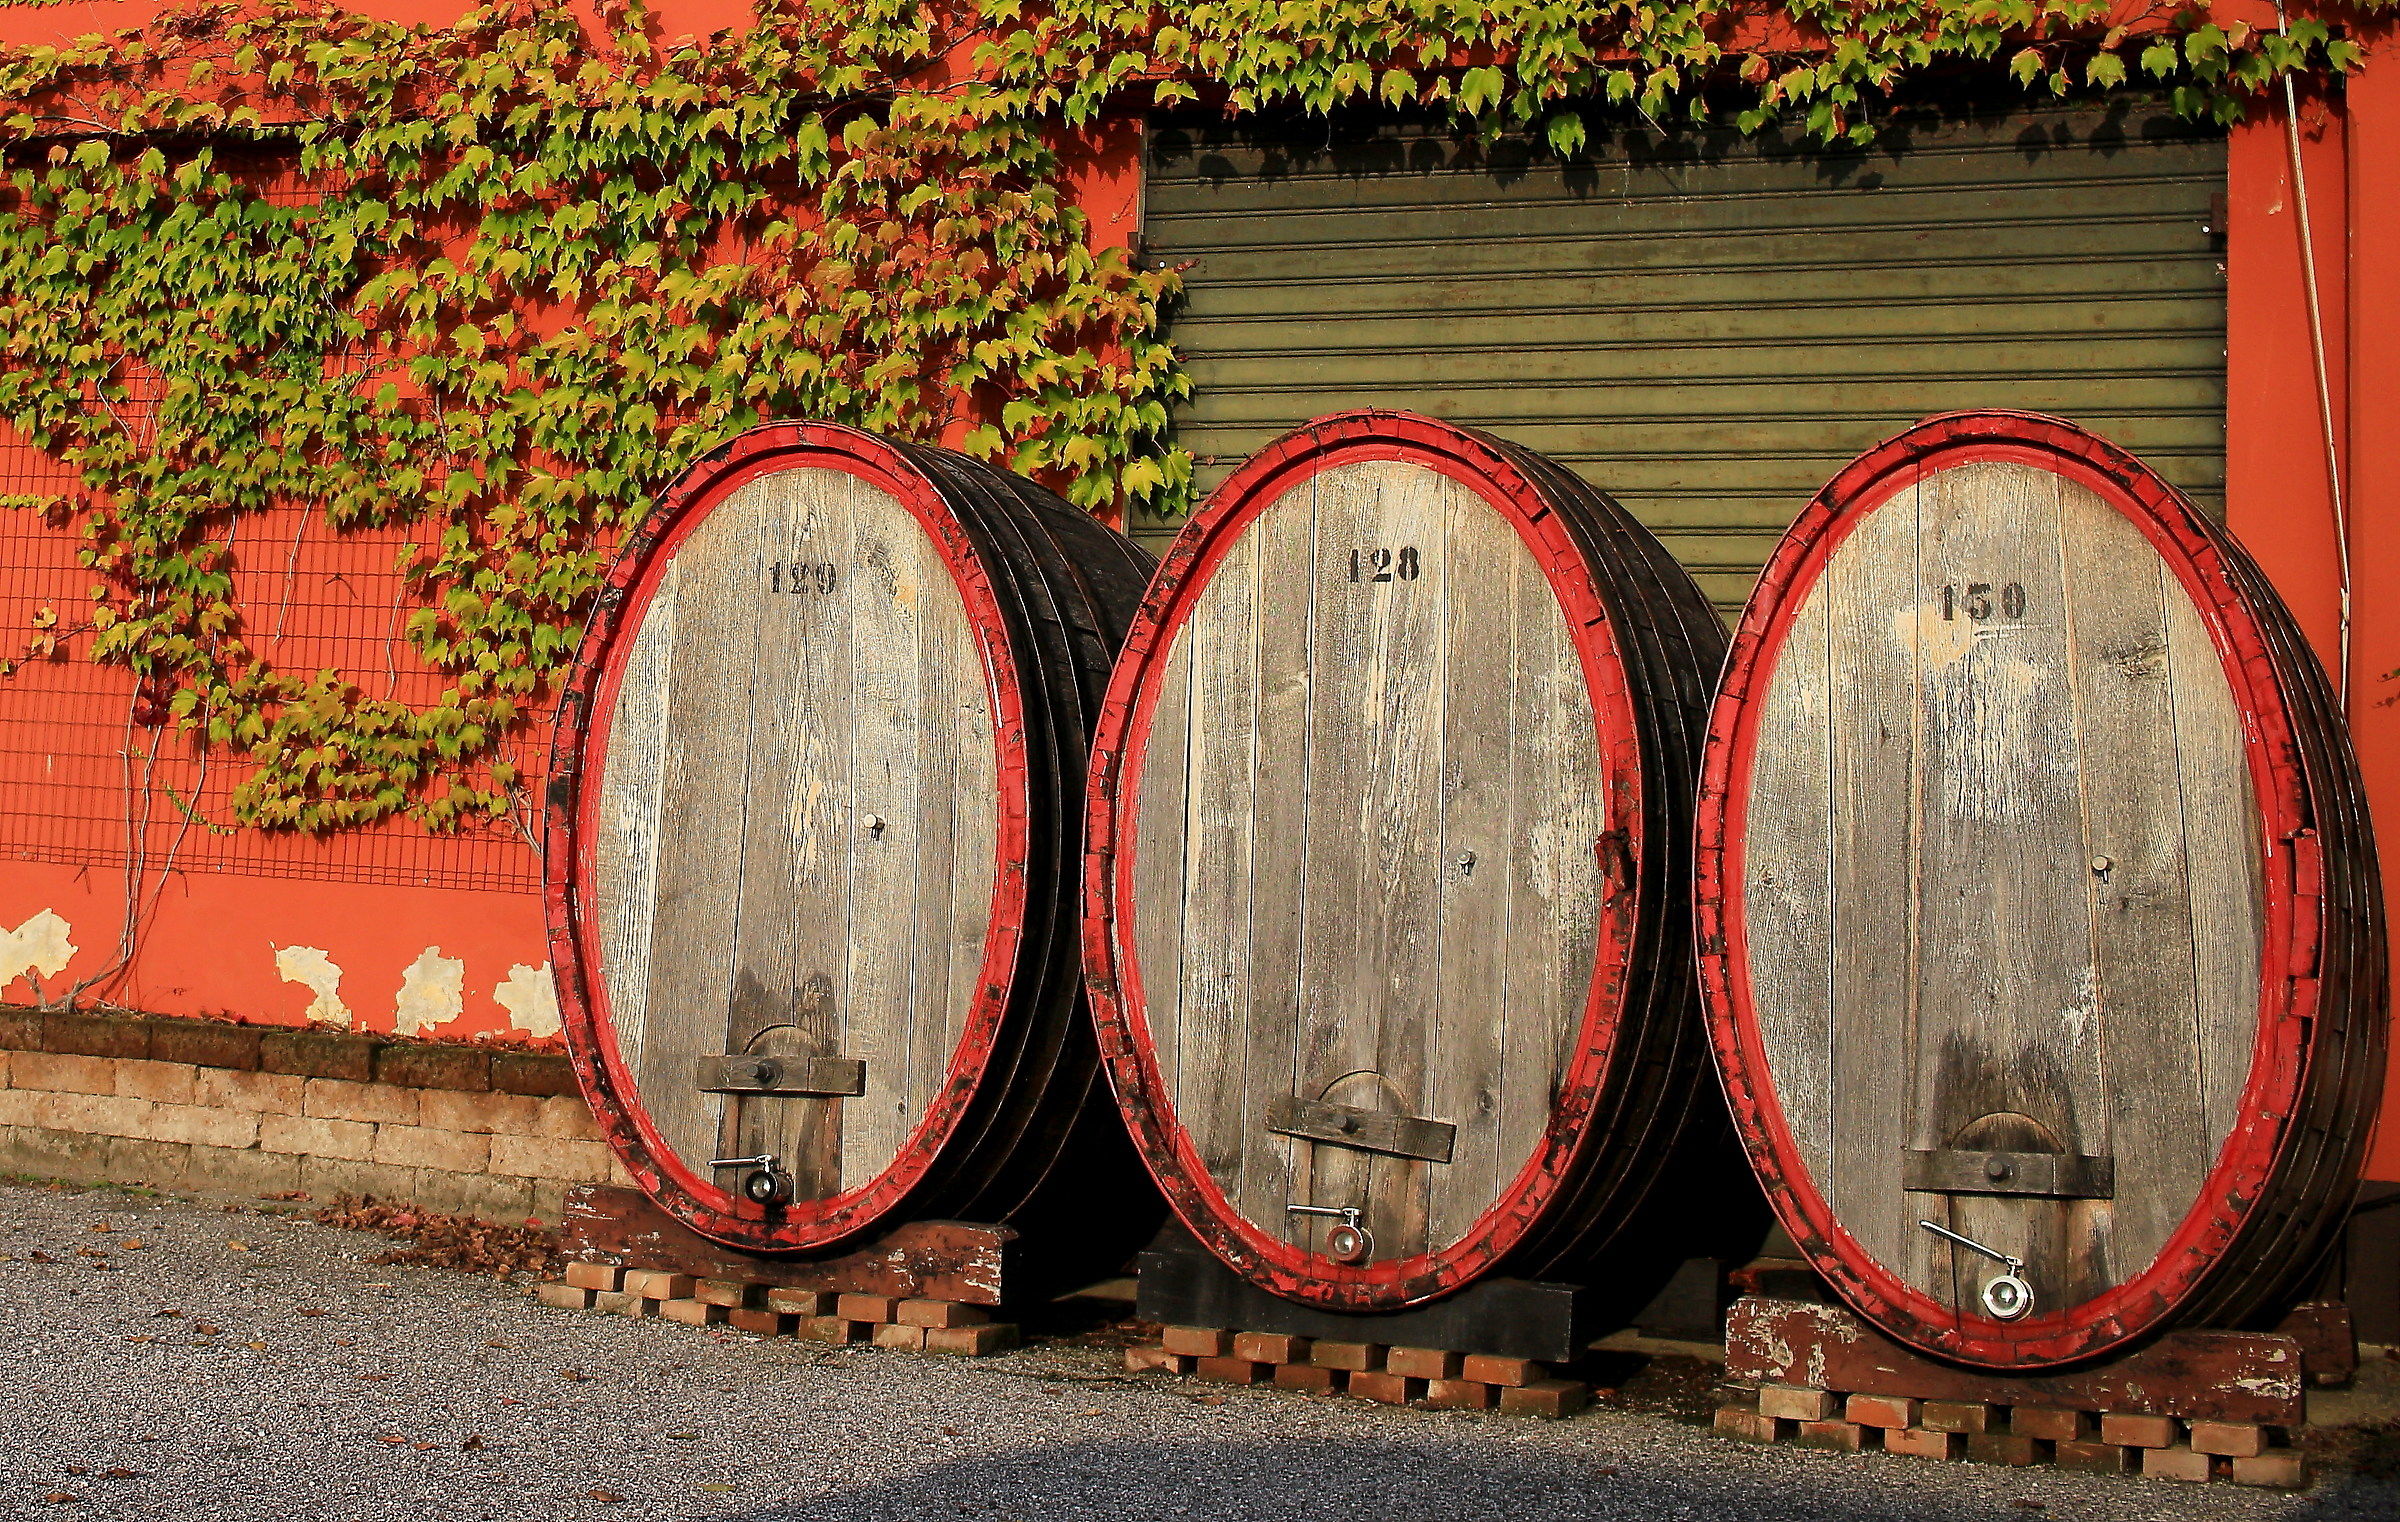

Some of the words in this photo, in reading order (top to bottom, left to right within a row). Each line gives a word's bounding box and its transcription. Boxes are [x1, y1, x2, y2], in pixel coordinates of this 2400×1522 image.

[769, 561, 837, 595] 129
[1349, 545, 1420, 583] 128
[1942, 581, 2027, 621] 150
